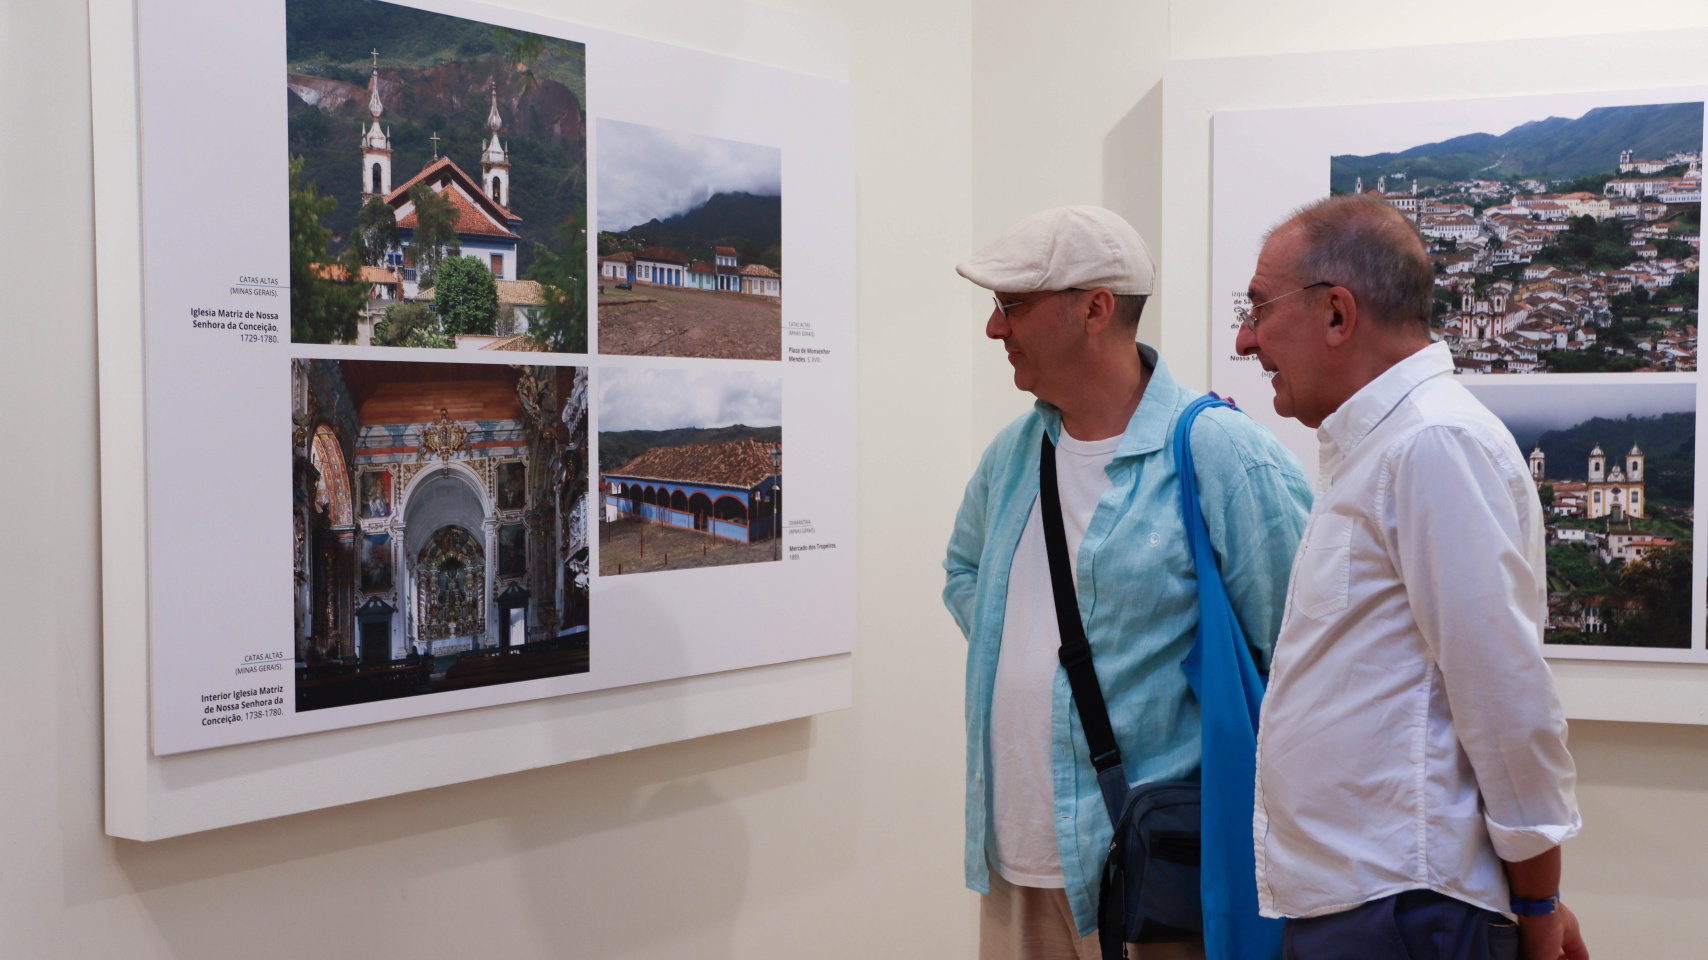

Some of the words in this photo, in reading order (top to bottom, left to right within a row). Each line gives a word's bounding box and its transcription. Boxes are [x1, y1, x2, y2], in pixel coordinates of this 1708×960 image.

[239, 276, 259, 284] CATAS
[259, 277, 279, 285] ALTAS
[230, 287, 253, 295] (MINAS
[253, 288, 279, 297] GERAIS).
[190, 307, 216, 318] Iglesia
[218, 309, 243, 318] Matriz
[244, 310, 254, 319] de
[255, 311, 279, 320] Nossa
[192, 319, 226, 329] Senhora
[227, 321, 237, 330] da
[238, 322, 279, 333] Conceição,
[240, 334, 279, 343] 1729-1780.
[244, 653, 264, 662] CATAS
[264, 651, 283, 660] ALTAS
[235, 666, 258, 675] (MINAS
[258, 663, 283, 672] GERAIS).
[201, 692, 232, 702] Interior
[233, 688, 258, 700] Iglesia
[259, 685, 284, 695] Matriz
[204, 705, 215, 714] de
[216, 703, 240, 712] Nossa
[241, 698, 273, 709] Senhora
[274, 696, 284, 704] da
[201, 713, 243, 726] Conceição,
[245, 707, 284, 719] 1738-1780.
